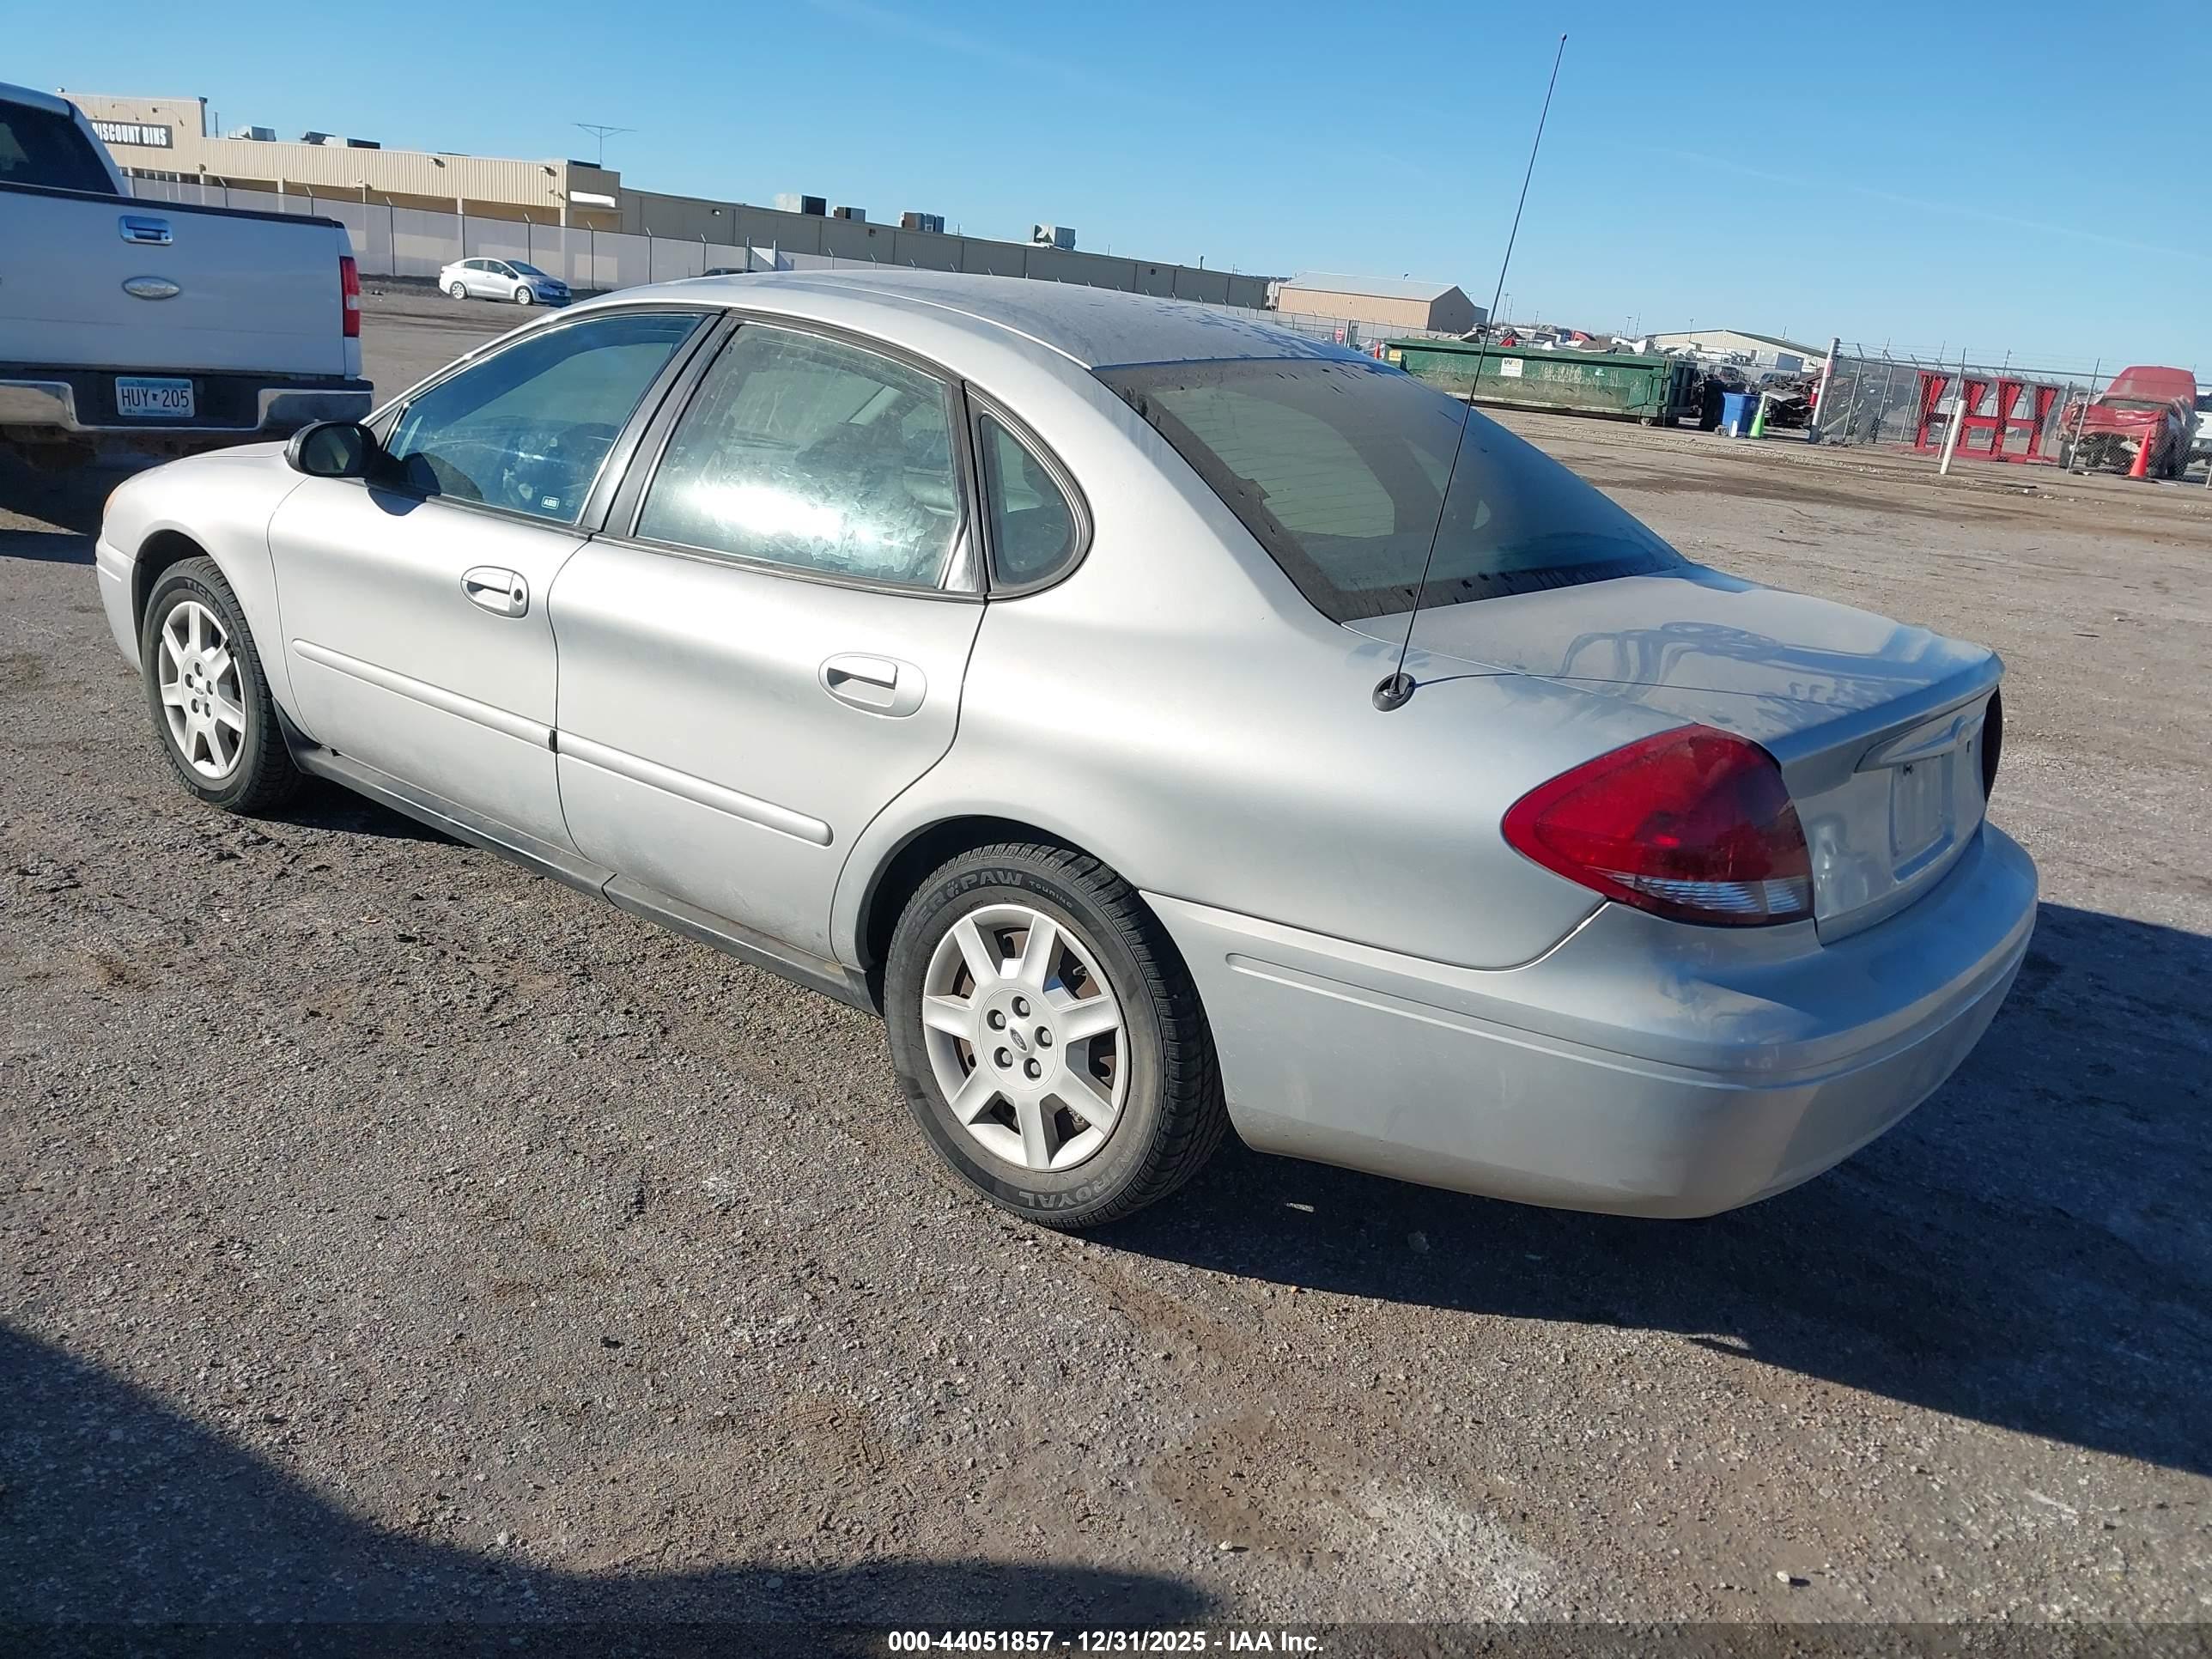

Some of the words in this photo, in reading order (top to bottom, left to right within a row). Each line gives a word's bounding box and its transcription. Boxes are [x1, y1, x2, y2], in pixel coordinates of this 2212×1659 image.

[142, 126, 167, 146] BINS
[121, 388, 149, 407] HUY
[161, 389, 189, 408] 205
[959, 870, 1024, 891] PAW
[1028, 880, 1073, 908] TOURING
